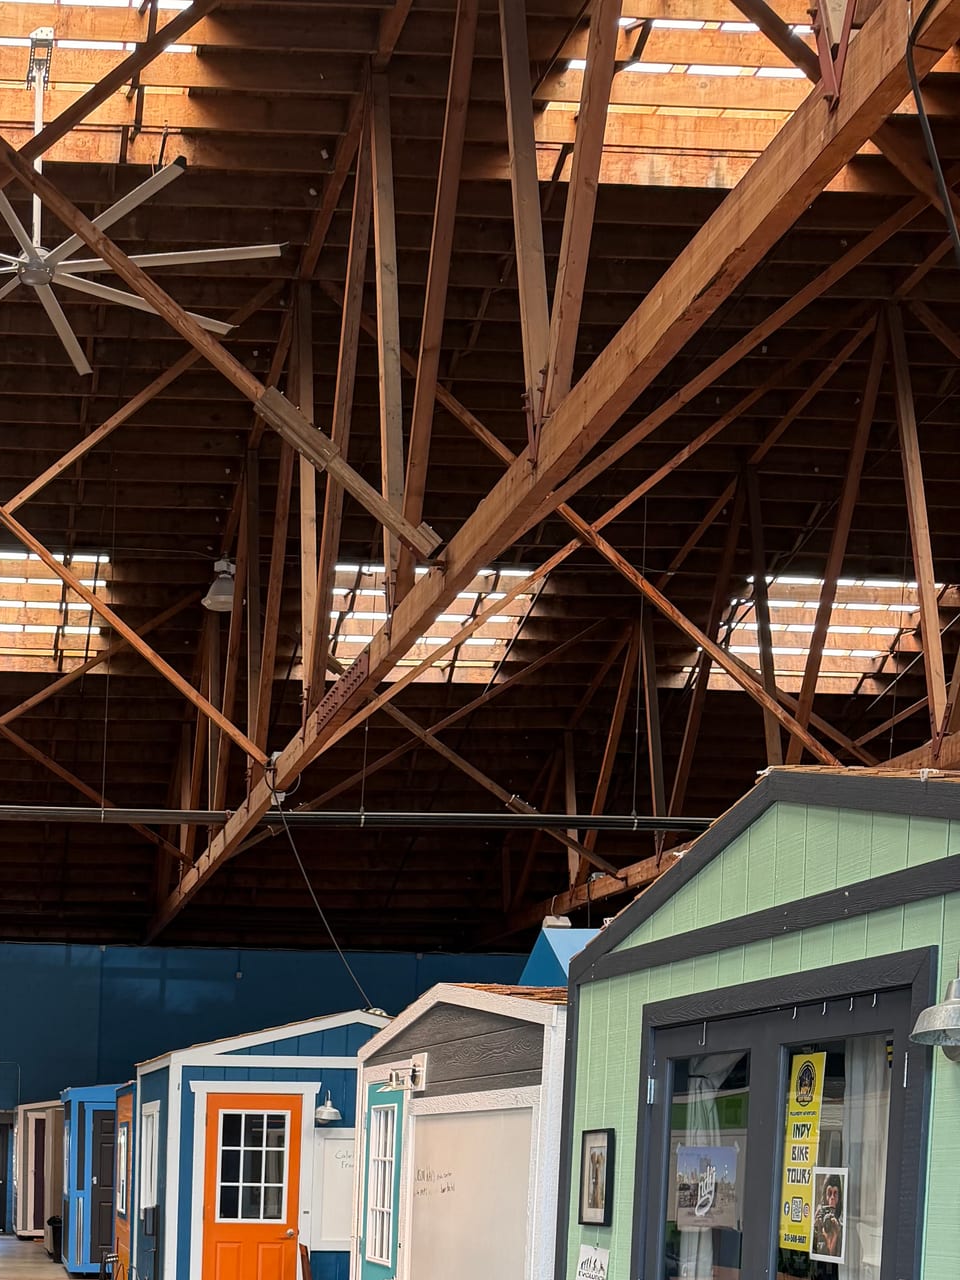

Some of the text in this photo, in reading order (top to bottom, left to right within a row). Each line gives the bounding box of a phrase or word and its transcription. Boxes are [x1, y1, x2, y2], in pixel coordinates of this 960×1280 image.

[792, 1123, 811, 1139] INDY
[791, 1145, 809, 1161] BIKE
[786, 1168, 811, 1184] TOURS
